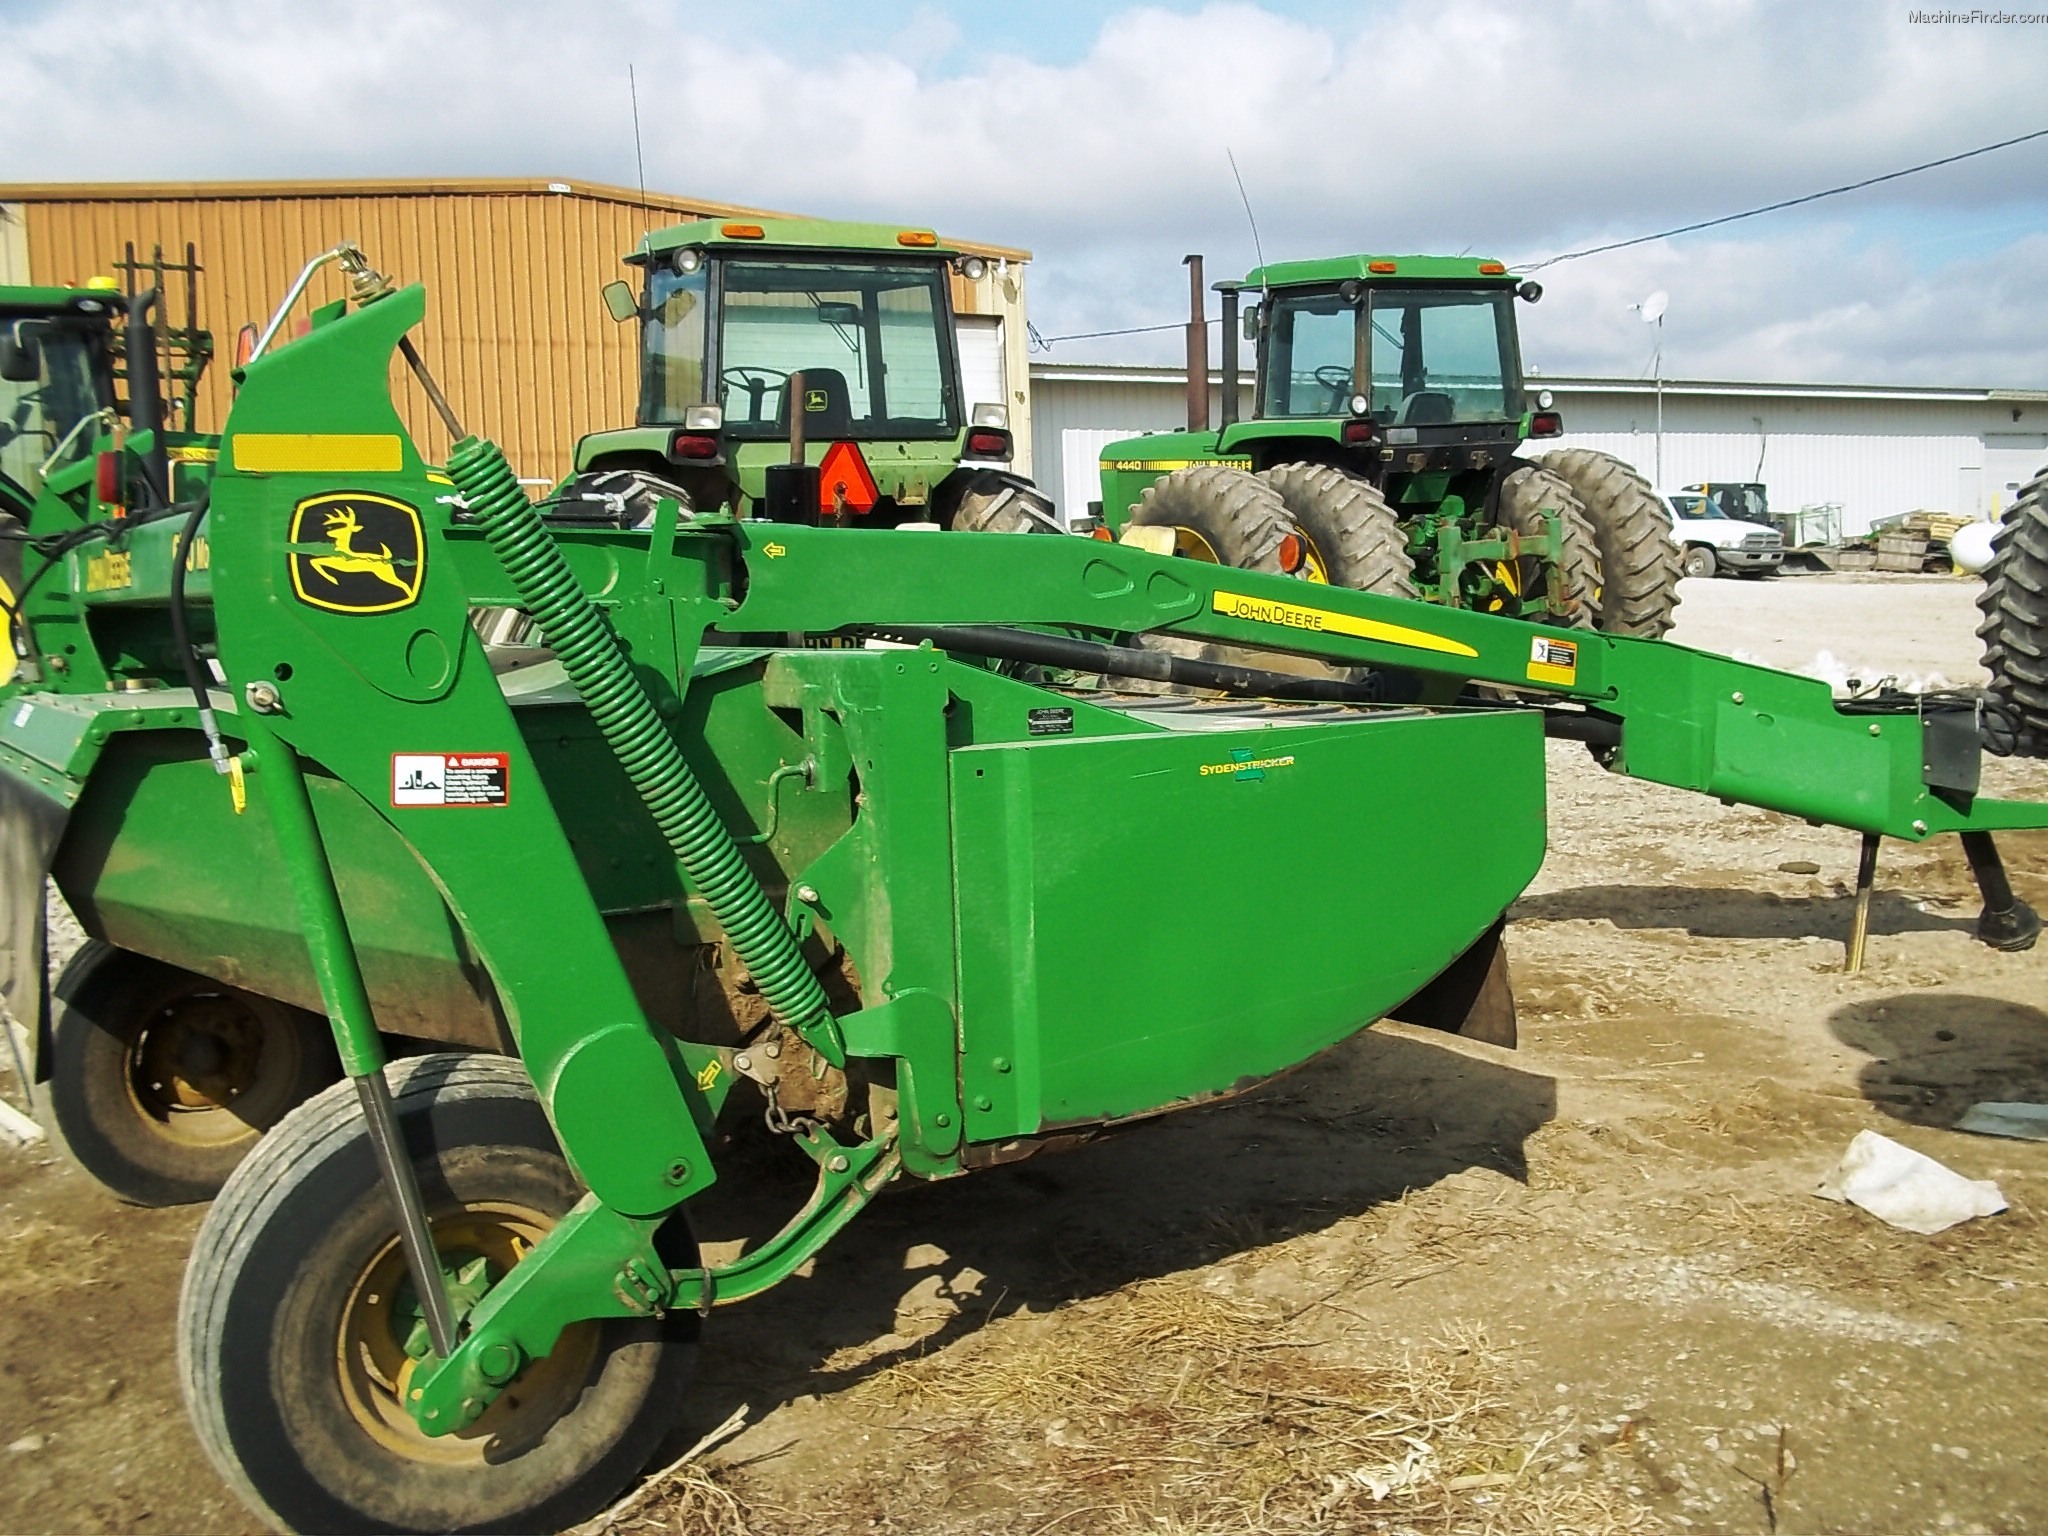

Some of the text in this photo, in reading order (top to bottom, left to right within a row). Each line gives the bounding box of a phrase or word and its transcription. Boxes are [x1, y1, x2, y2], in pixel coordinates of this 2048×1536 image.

[1116, 460, 1142, 471] 4440
[1217, 460, 1250, 472] DEERE
[1230, 599, 1323, 628] JOHN DEERE
[461, 758, 499, 767] DANGER
[1199, 756, 1295, 776] SYDENSTRICKER
